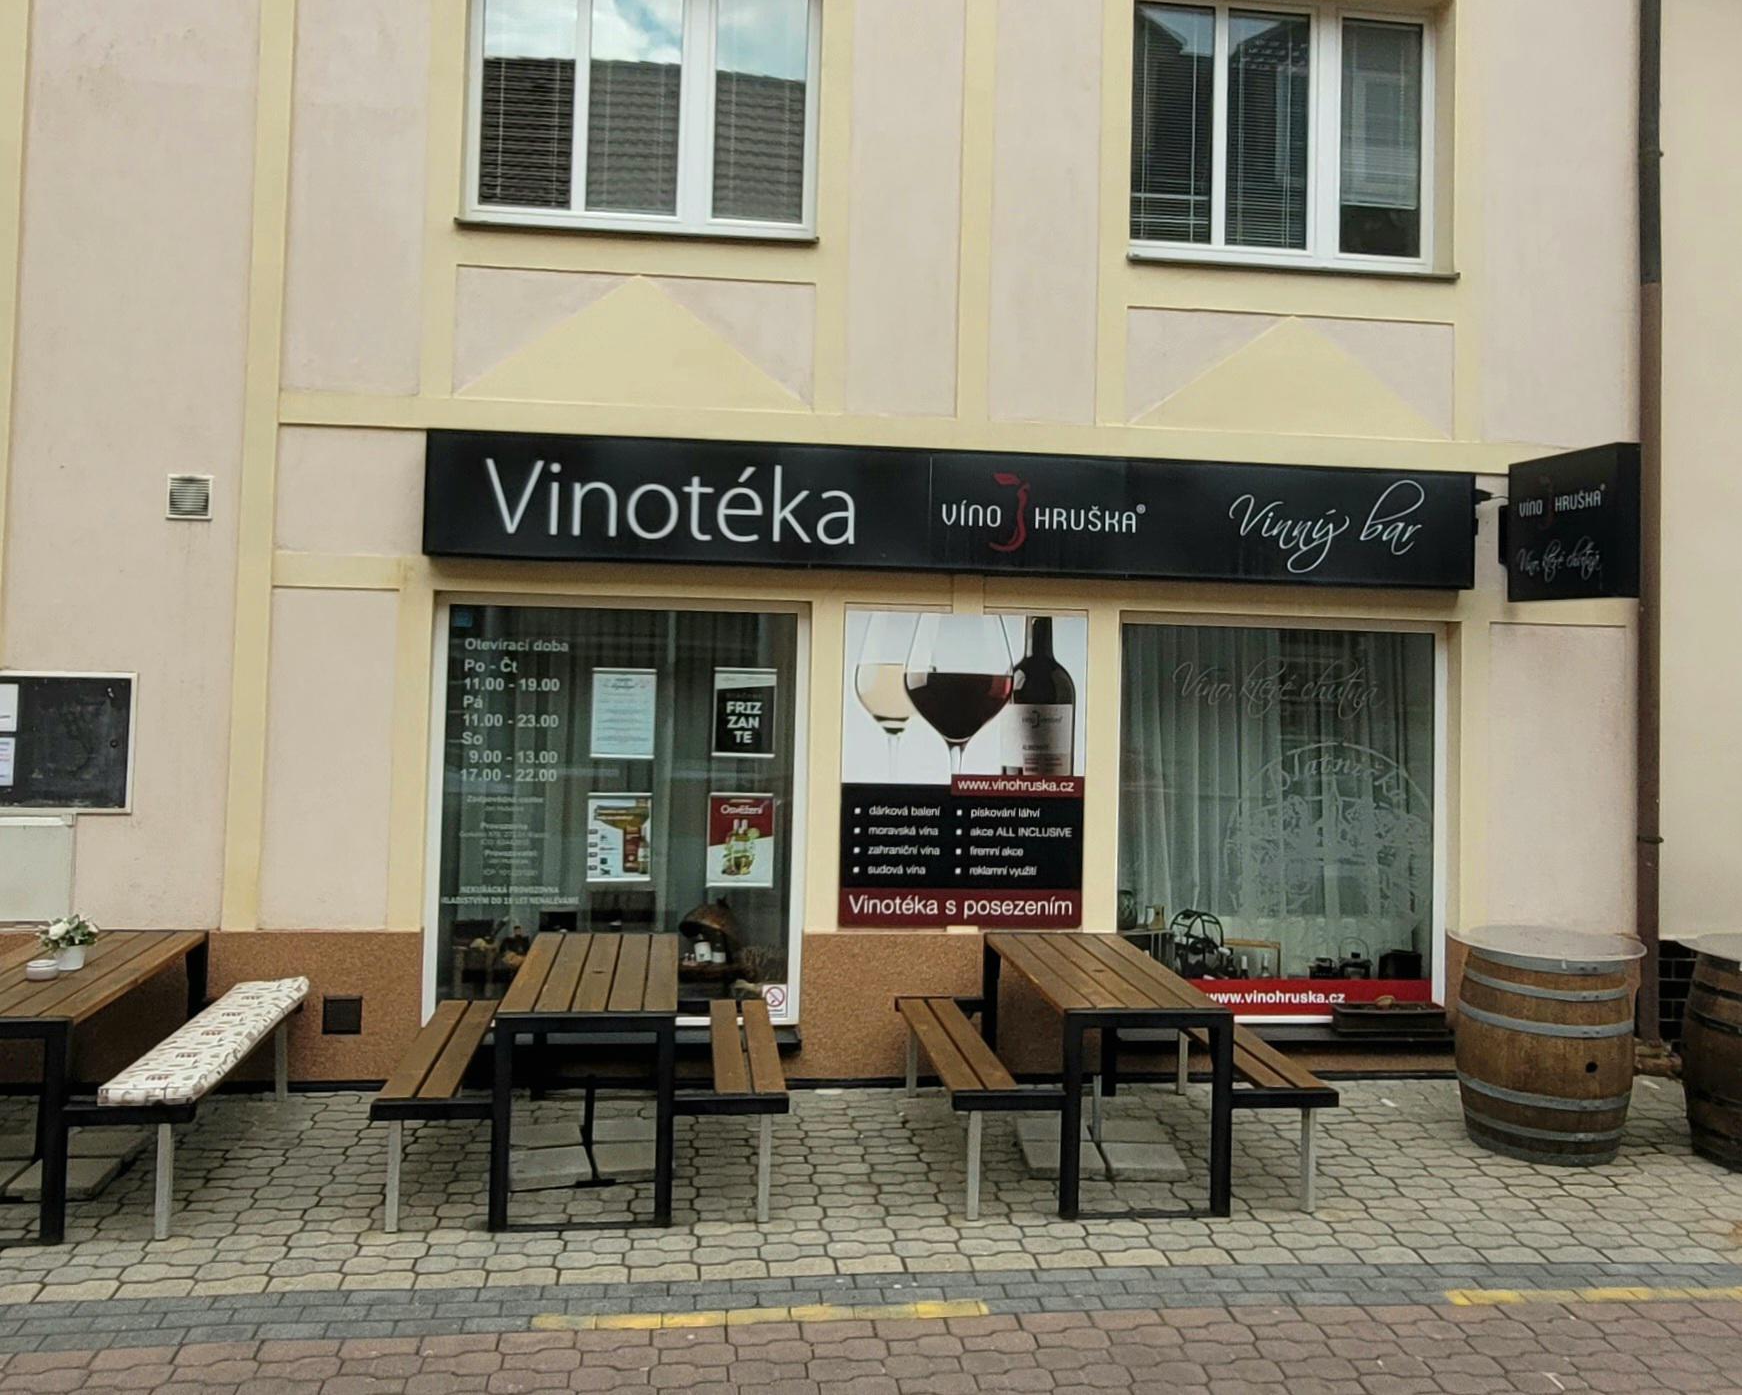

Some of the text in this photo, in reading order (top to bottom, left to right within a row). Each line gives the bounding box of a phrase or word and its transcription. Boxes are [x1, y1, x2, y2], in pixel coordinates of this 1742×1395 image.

[485, 457, 857, 546] Vinotéka
[1034, 505, 1138, 534] HRUŠKA
[1228, 479, 1426, 574] Vinný bar
[532, 639, 570, 653] doba
[463, 658, 486, 673] Po
[500, 656, 519, 674] Čt
[463, 676, 505, 692] 11.00
[518, 677, 561, 692] 19.00
[463, 694, 484, 709] Pá
[726, 701, 763, 715] FRIZ
[462, 712, 504, 727] 11.00
[516, 713, 560, 728] 23.00
[727, 715, 761, 729] ZAN
[462, 731, 484, 746] So
[733, 730, 753, 744] TE
[469, 749, 503, 764] 9.00
[518, 750, 559, 764] 13.00
[460, 767, 502, 782] 17.00
[515, 768, 558, 783] 22.00
[957, 778, 1075, 793] www.vinohruska.cz
[868, 805, 941, 817] dárková balení
[970, 807, 1041, 820] pískování láhví
[868, 825, 939, 836] moravská vína
[969, 827, 1073, 838] akce ALL INCLUSIVE
[867, 845, 941, 856] zahraniční vína
[969, 846, 1024, 857] firemní akce
[867, 864, 927, 875] sudová vína
[969, 866, 1008, 876] reklamní
[849, 894, 1073, 919] Vinotéka s posezením
